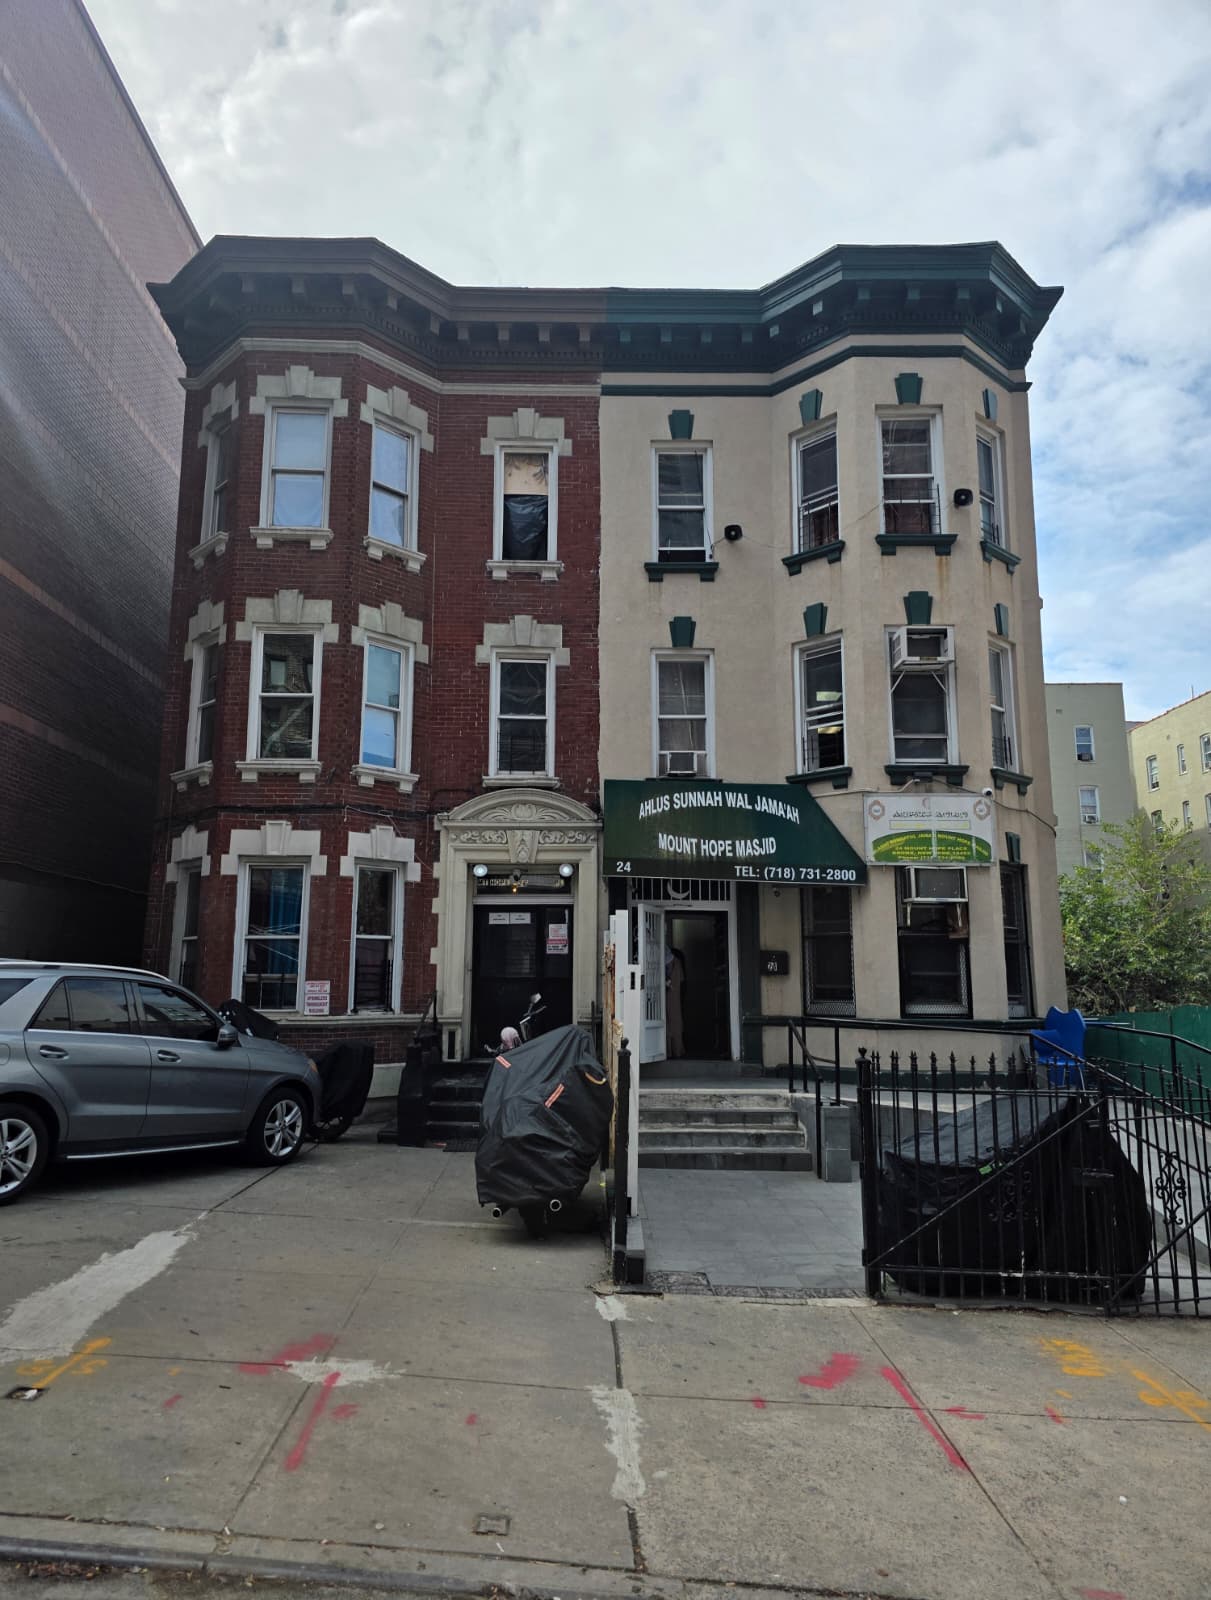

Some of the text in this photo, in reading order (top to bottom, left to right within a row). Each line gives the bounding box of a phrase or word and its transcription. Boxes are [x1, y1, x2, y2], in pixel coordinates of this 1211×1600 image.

[639, 791, 800, 824] AHLUS SUNNAH WAL JAMA'AH
[658, 832, 777, 857] MOUNT HOPE MASJID
[616, 861, 857, 881] 24 TEL: (718) 731-2800
